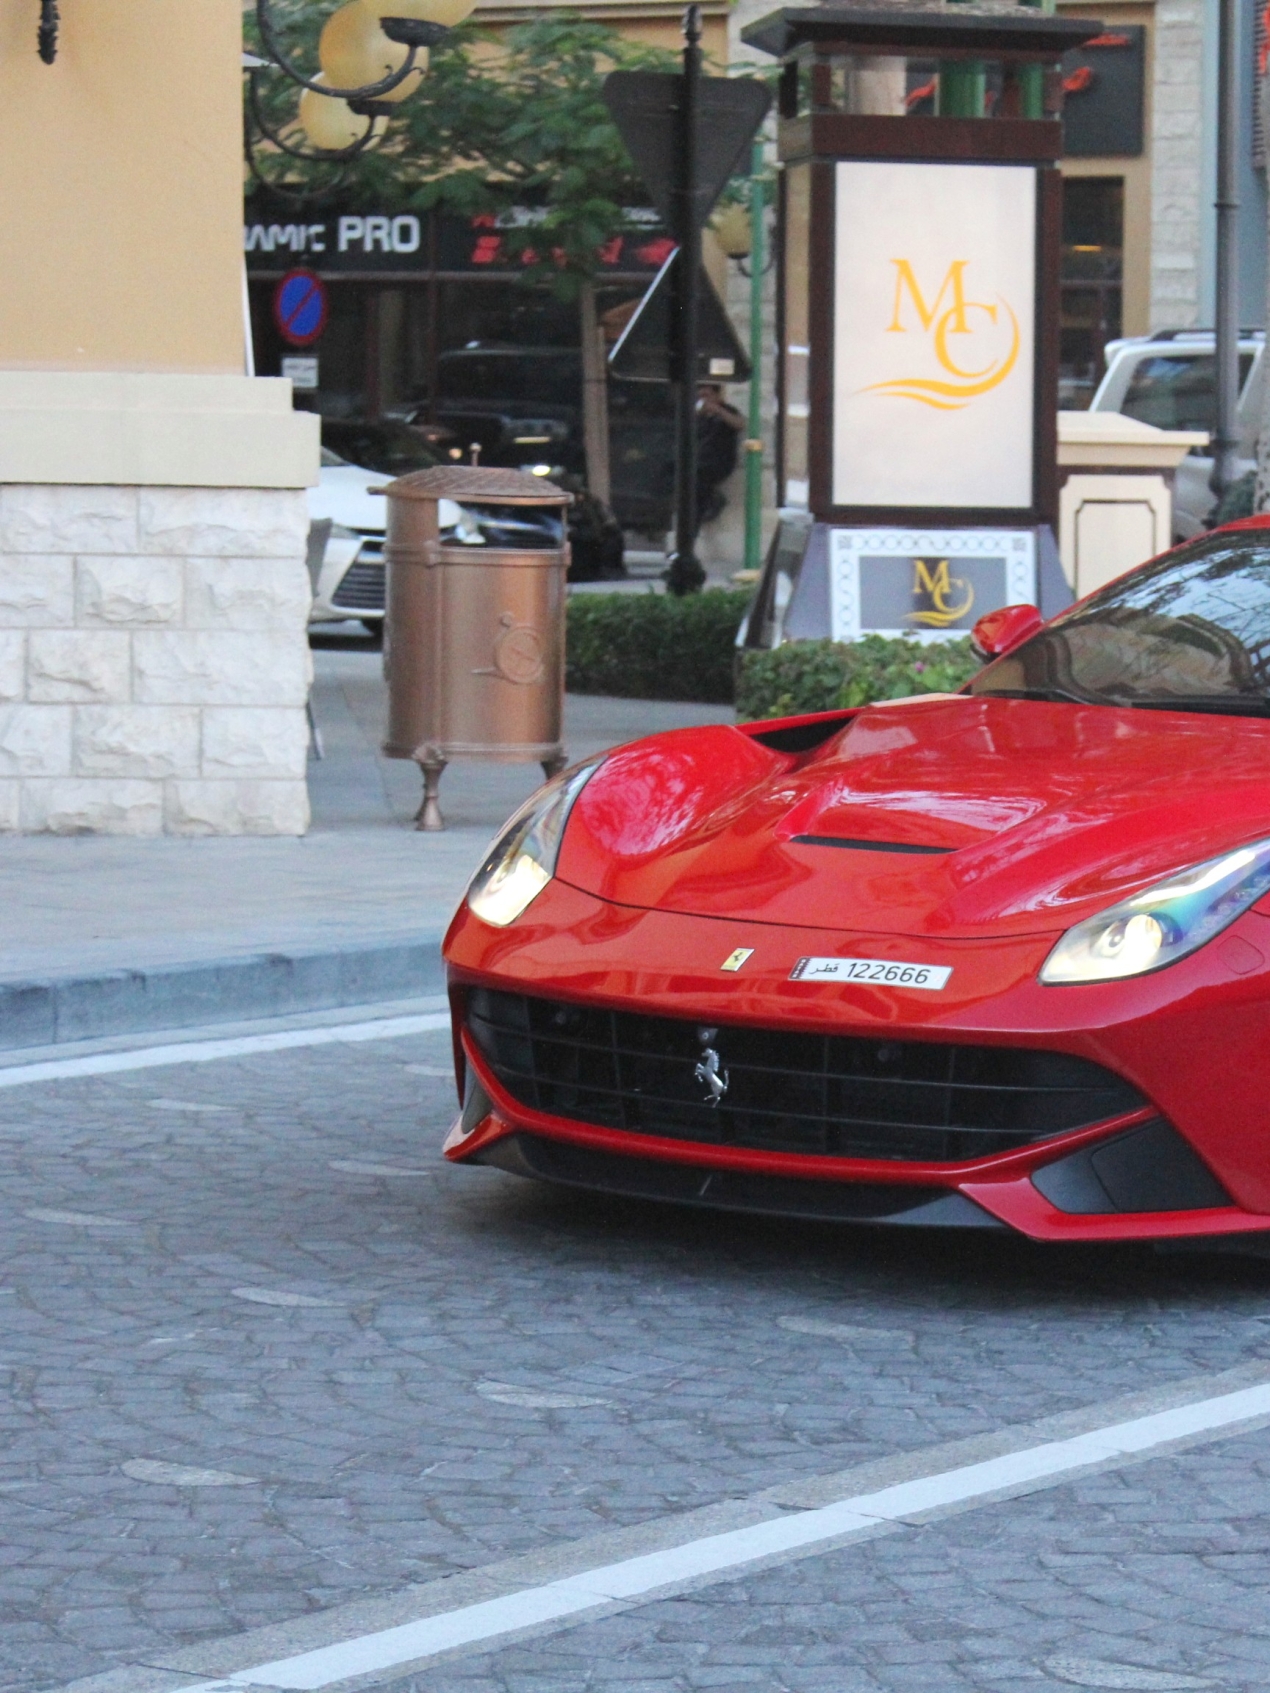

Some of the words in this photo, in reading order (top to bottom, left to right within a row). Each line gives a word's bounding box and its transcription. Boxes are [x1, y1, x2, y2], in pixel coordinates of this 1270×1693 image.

[244, 224, 325, 251] AMIC
[338, 215, 421, 253] PRO
[885, 257, 1000, 378] MC
[847, 962, 931, 984] 122666
